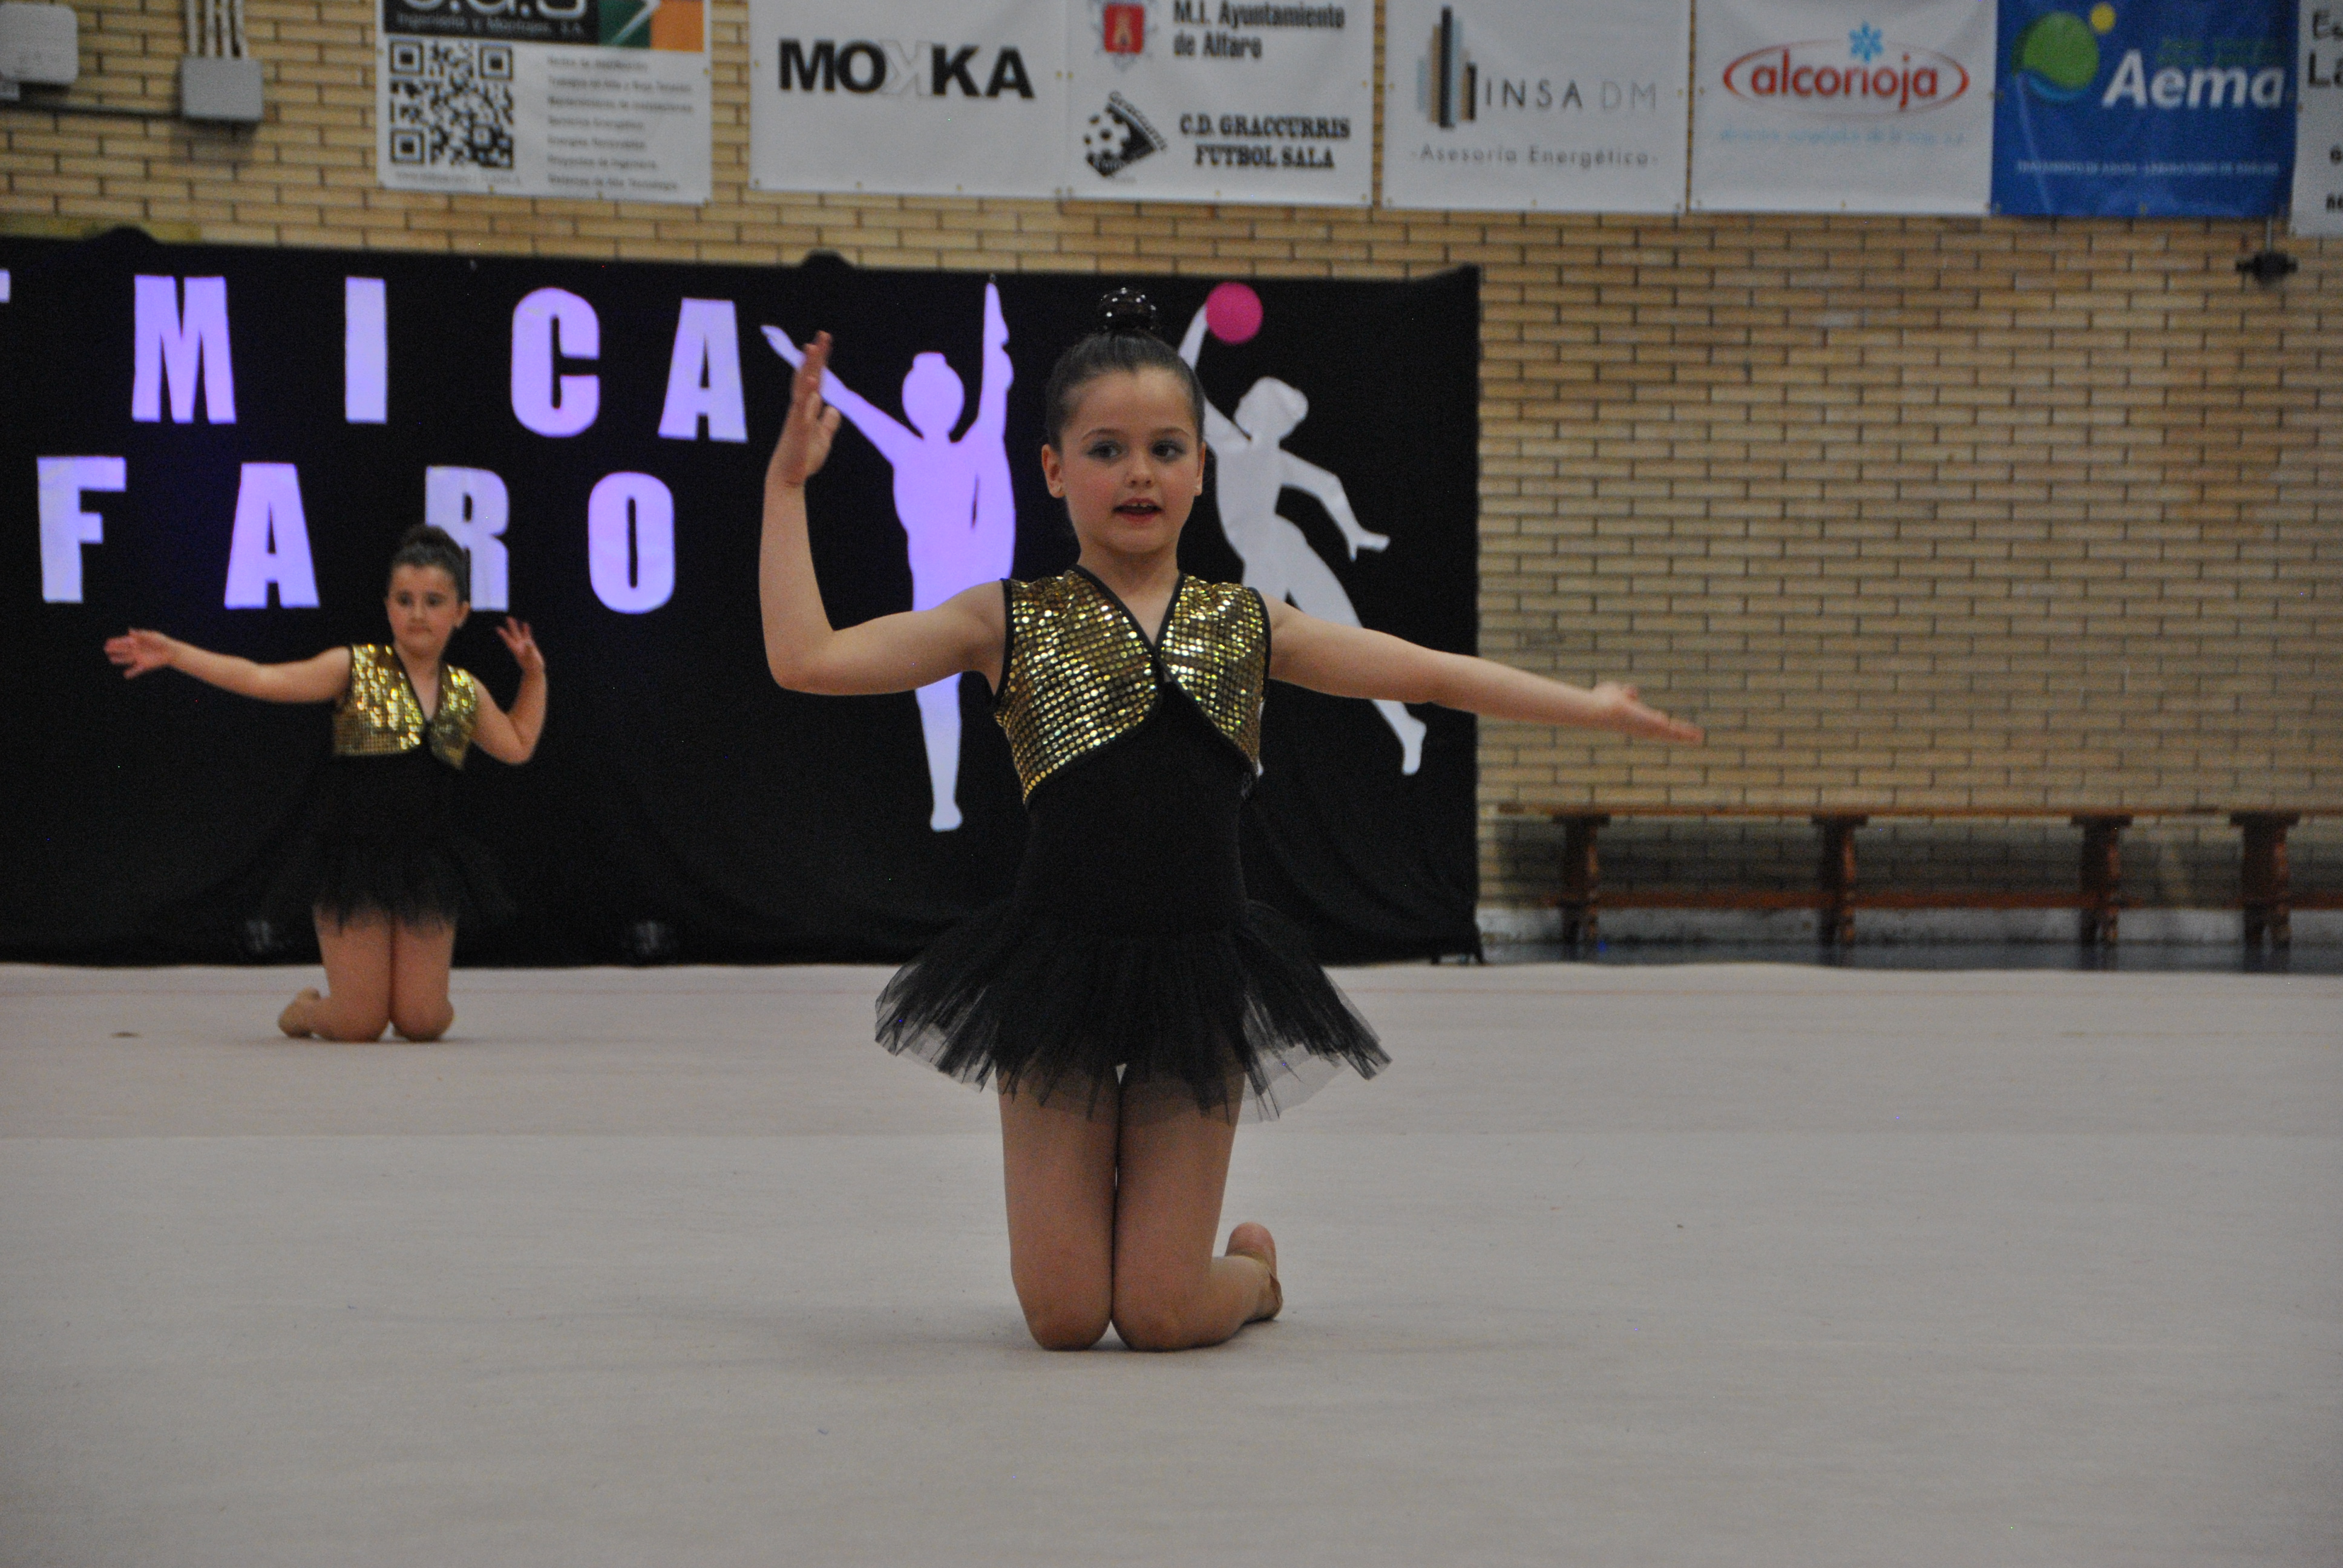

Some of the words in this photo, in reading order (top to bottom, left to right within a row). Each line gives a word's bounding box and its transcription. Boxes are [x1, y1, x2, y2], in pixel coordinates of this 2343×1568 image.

[1174, 31, 1196, 56] de
[1204, 32, 1262, 59] Alfaro
[1486, 79, 1583, 109] INSA
[1601, 81, 1656, 111] DM
[1752, 48, 1937, 111] alcorioja
[2102, 50, 2286, 109] Aema
[1281, 145, 1335, 169] SALA
